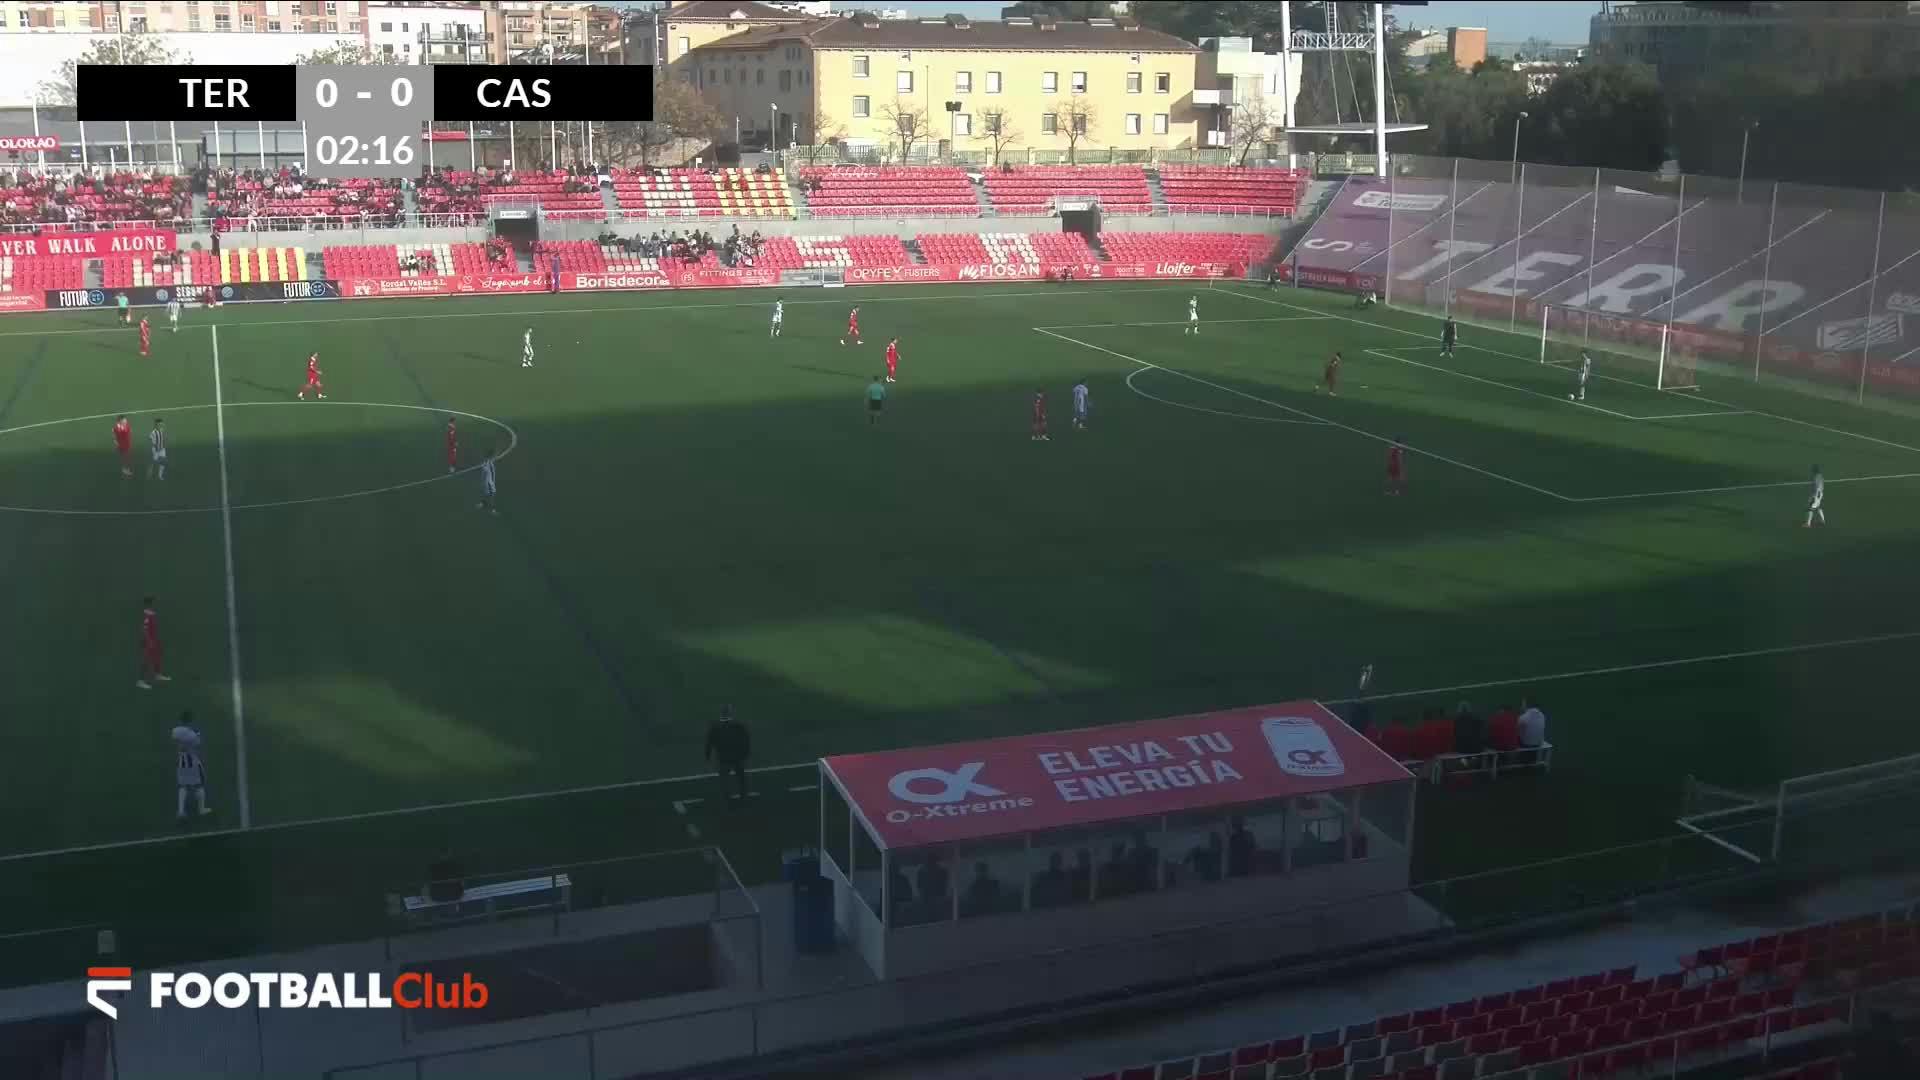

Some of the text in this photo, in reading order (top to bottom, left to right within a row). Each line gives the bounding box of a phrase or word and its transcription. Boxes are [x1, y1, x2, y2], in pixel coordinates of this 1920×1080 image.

[48, 238, 96, 255] WALK
[112, 236, 166, 252] ALONE
[904, 267, 940, 278] FUSTERS
[980, 263, 1040, 277] FIOSAN
[1156, 262, 1196, 277] Lloifer
[1037, 731, 1235, 776] ELEVA TU
[1055, 761, 1245, 803] ENERGÍA
[885, 793, 1035, 824] O-Xtreme
